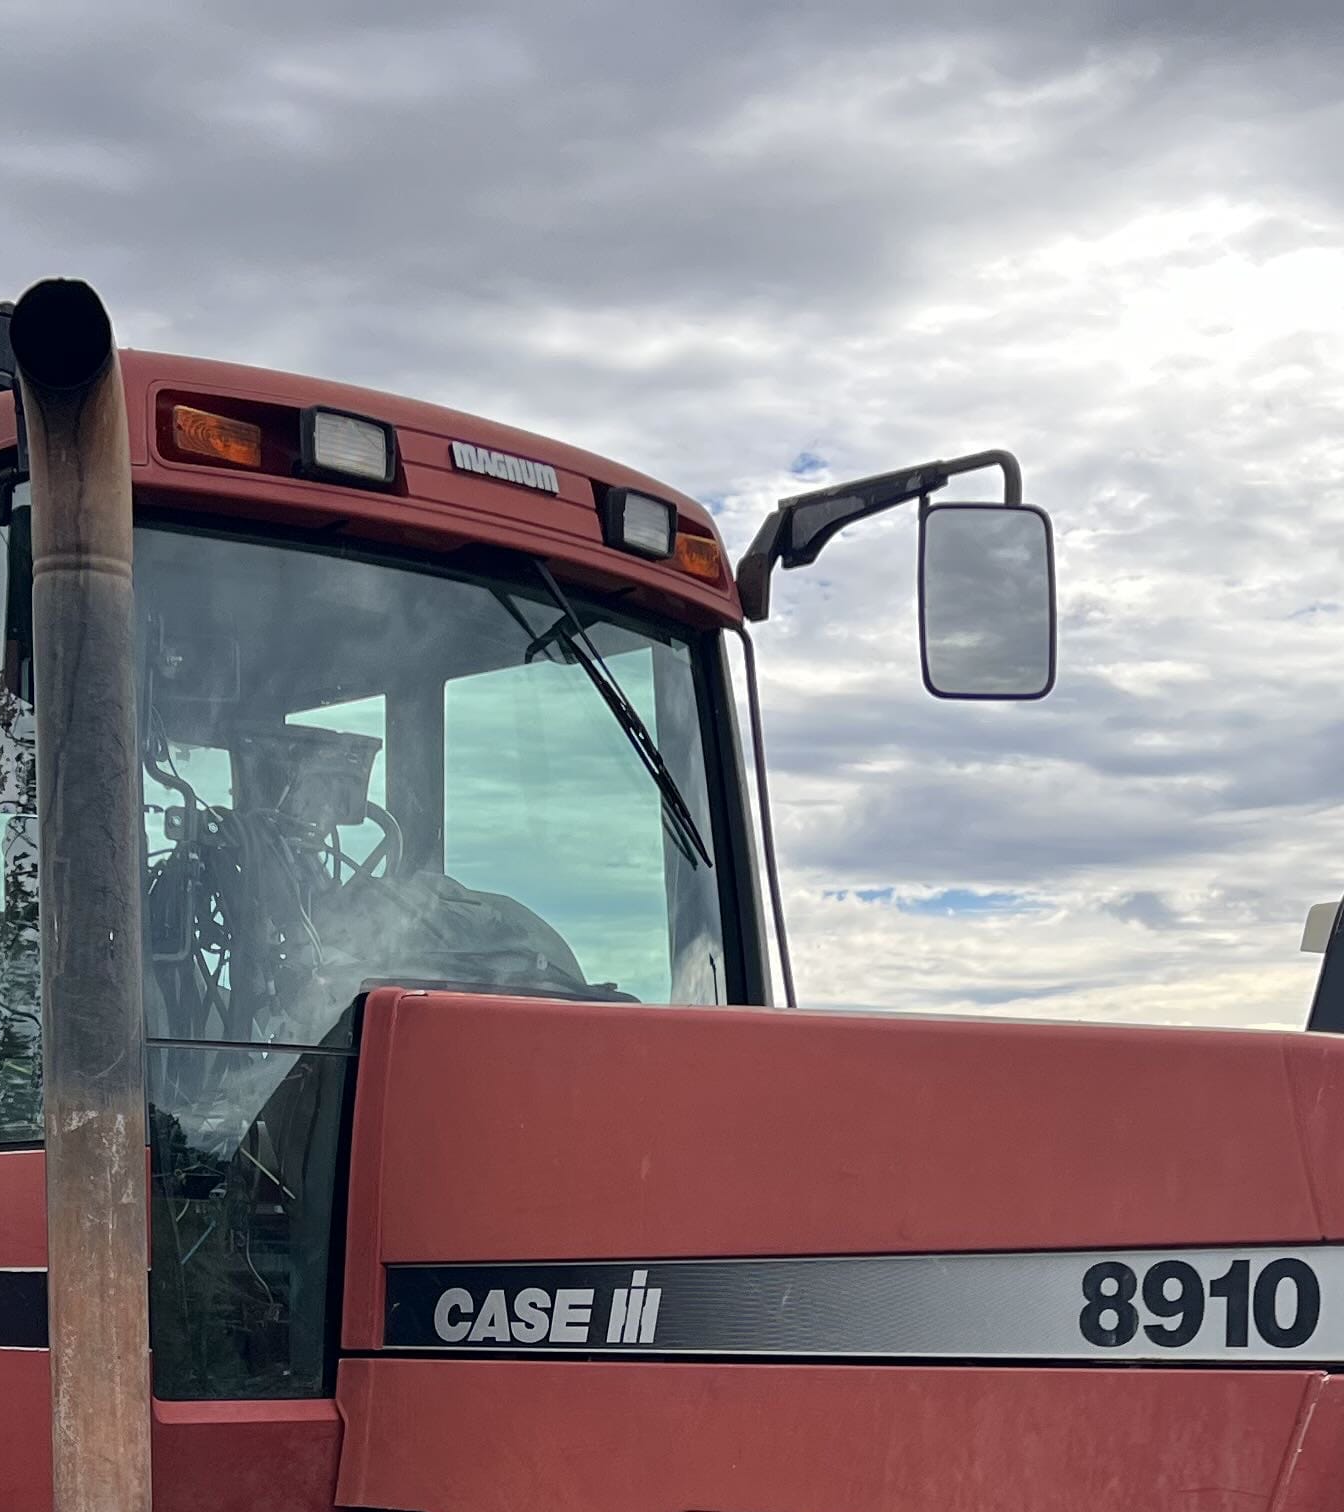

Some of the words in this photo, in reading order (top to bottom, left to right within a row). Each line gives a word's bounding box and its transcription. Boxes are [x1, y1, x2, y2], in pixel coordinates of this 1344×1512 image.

[452, 440, 560, 493] MAGNUM
[434, 1288, 592, 1343] CASE
[1079, 1258, 1320, 1349] 8910
